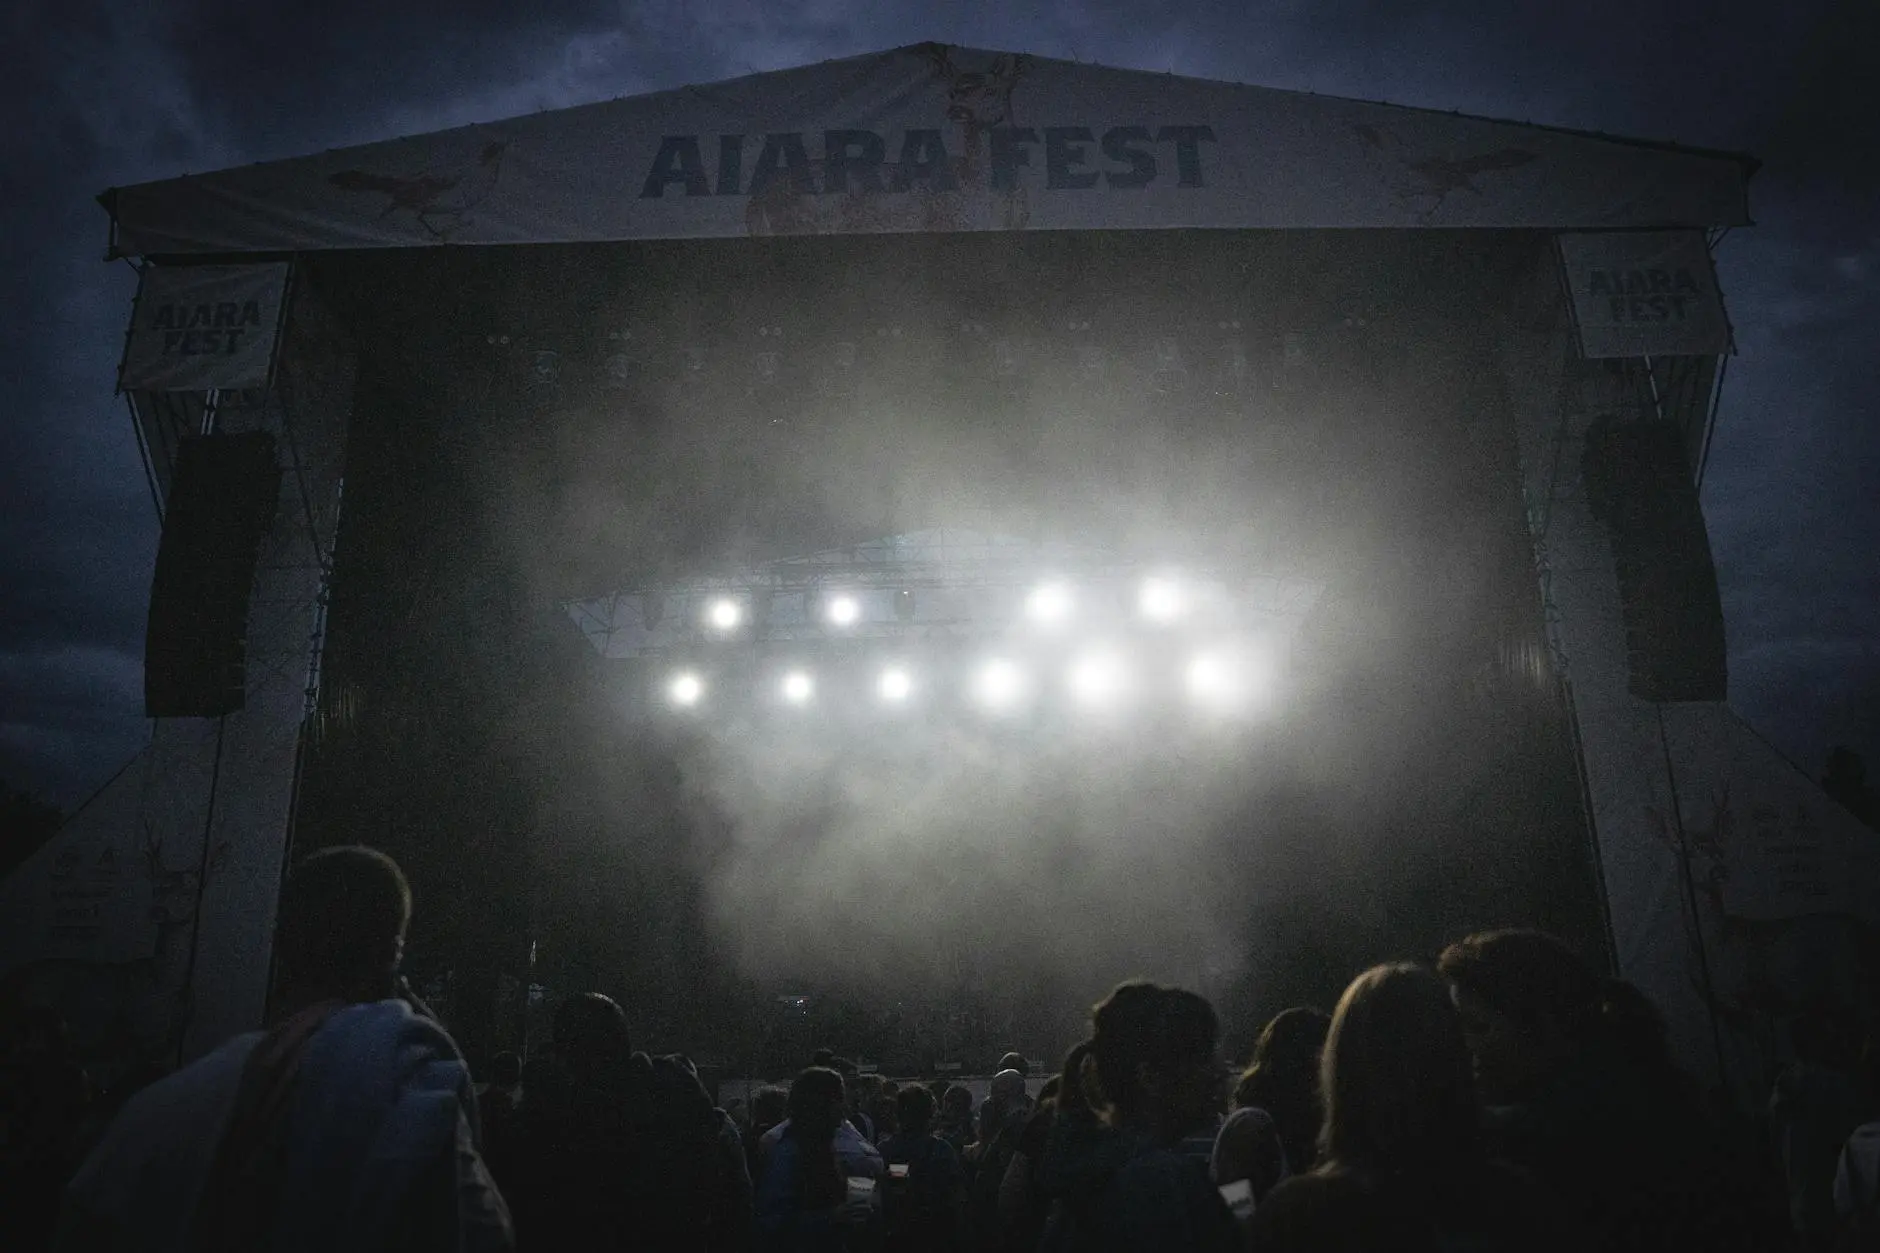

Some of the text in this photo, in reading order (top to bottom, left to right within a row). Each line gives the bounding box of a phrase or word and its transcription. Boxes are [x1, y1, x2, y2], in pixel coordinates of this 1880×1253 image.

[639, 125, 1217, 198] AIARA FEST
[1589, 269, 1700, 297] AIARA
[152, 300, 261, 330] AIARA
[1609, 296, 1687, 321] FEST
[162, 329, 244, 356] FEST
